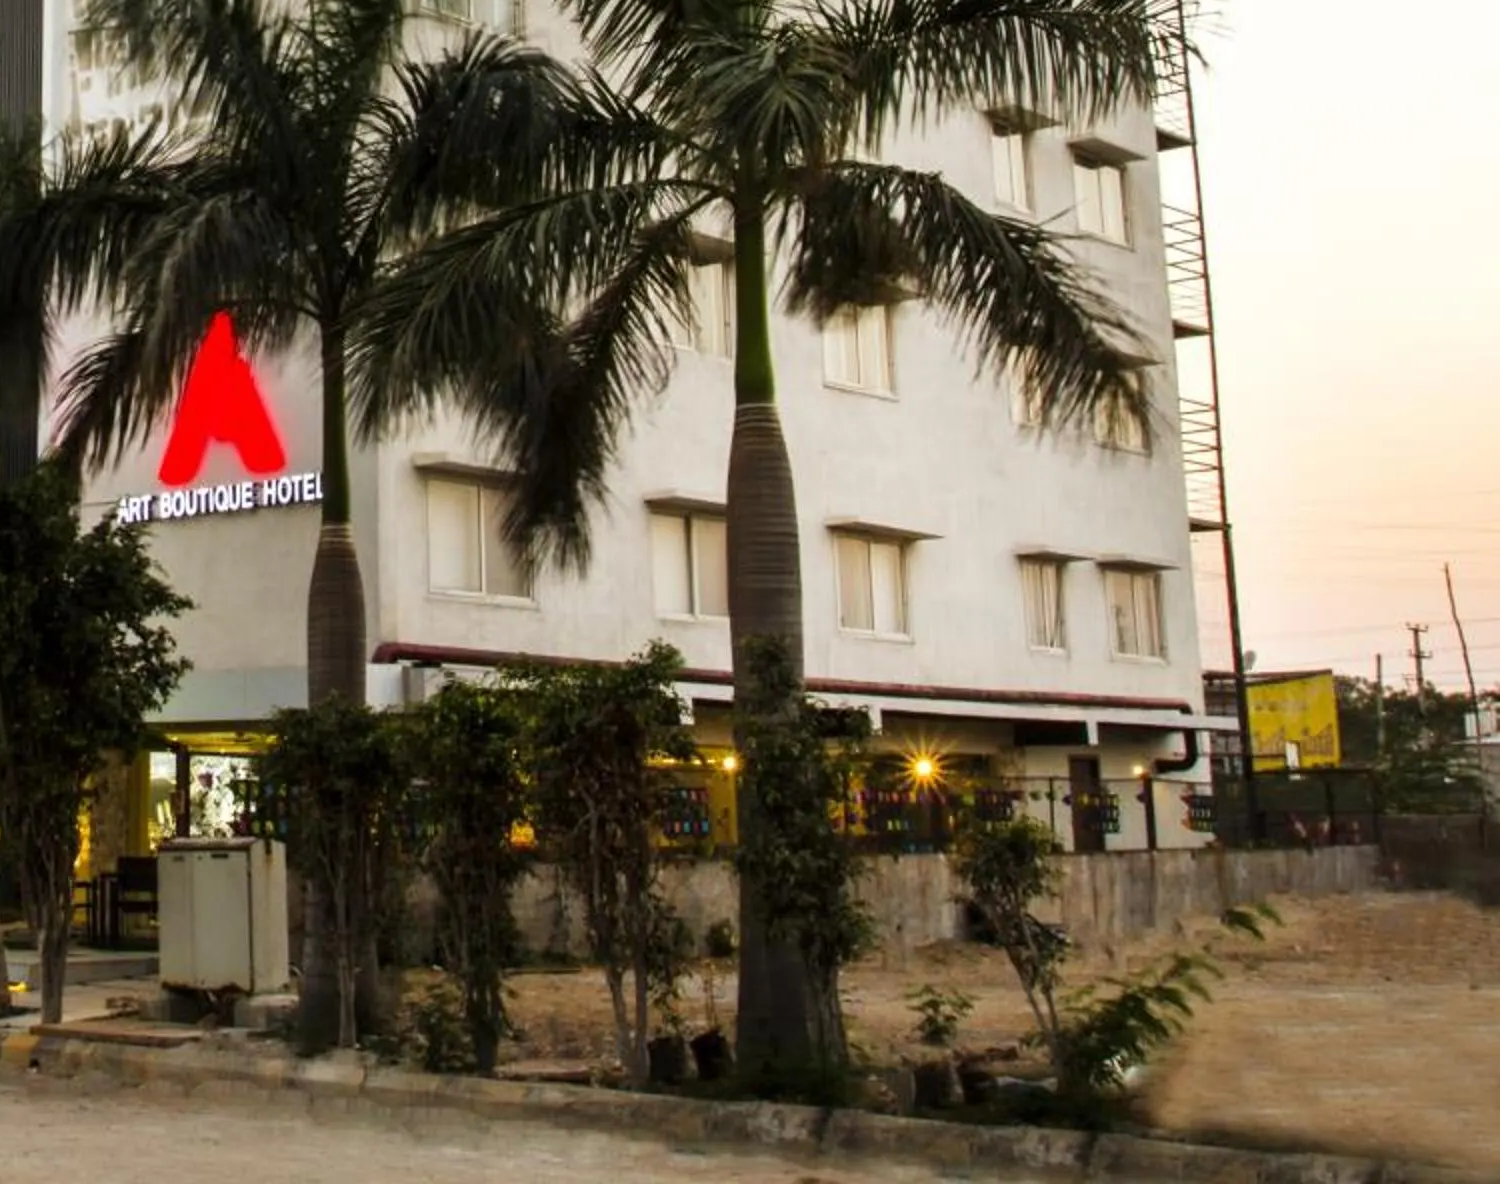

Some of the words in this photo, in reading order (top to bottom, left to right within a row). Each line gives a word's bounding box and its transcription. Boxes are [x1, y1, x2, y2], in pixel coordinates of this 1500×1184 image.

[117, 494, 153, 524] ART
[159, 481, 254, 519] BOUTIQUE
[263, 472, 324, 506] HOTEL
